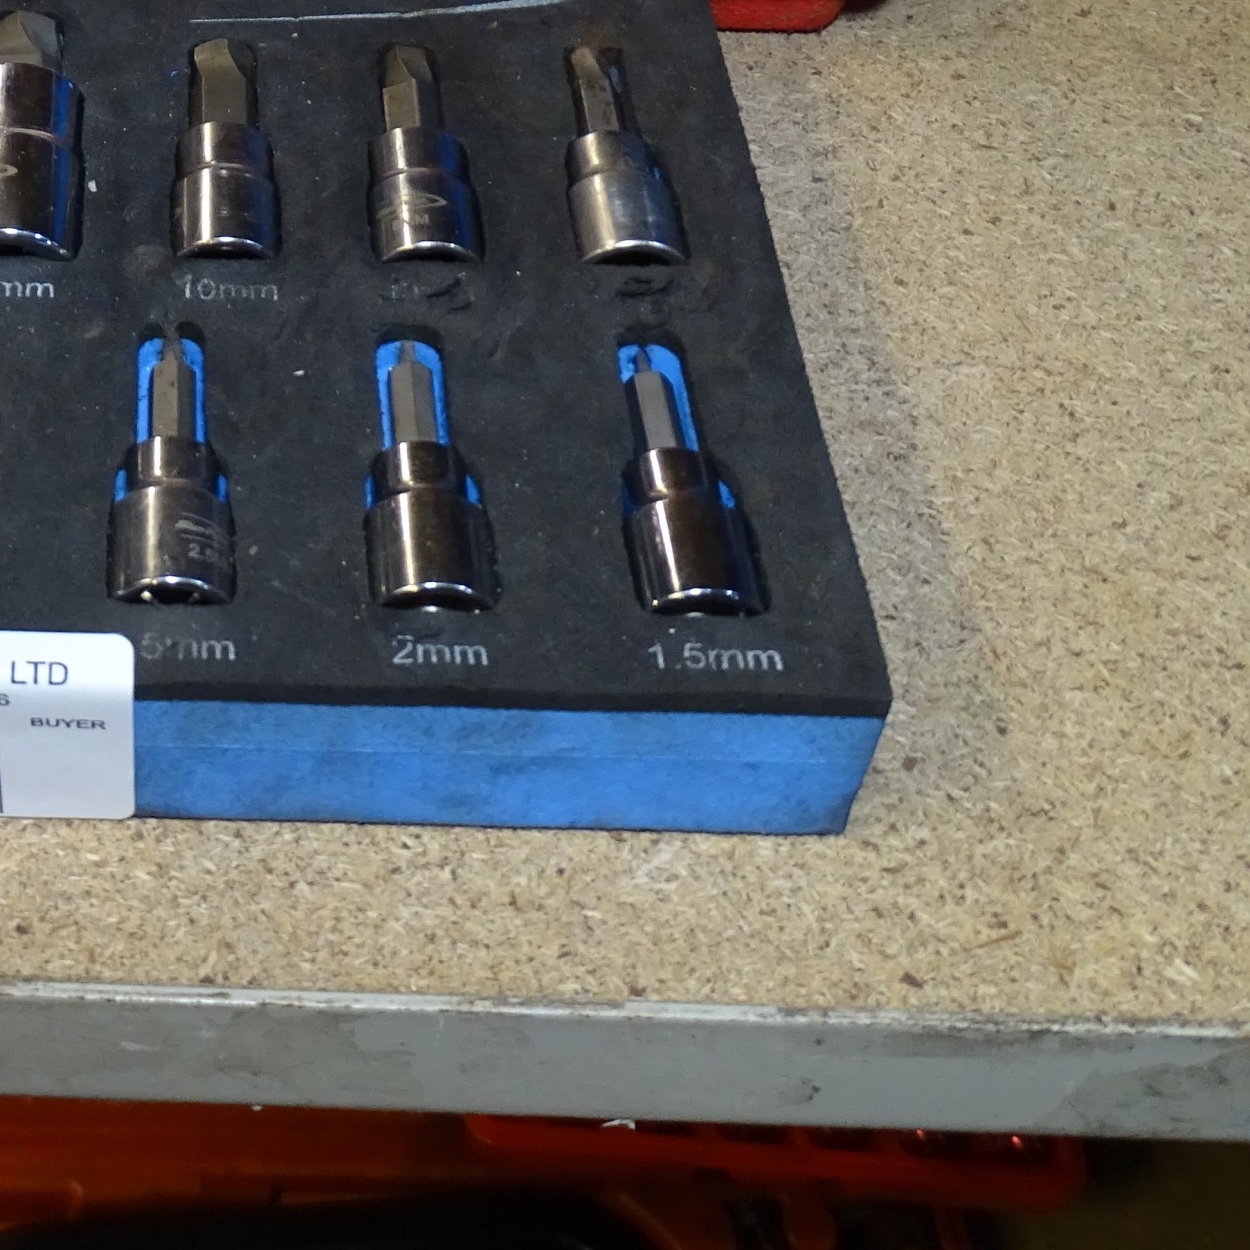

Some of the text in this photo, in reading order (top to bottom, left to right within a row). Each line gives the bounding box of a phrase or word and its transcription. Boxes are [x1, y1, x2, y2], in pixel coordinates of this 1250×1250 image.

[182, 274, 279, 302] 10mm
[391, 635, 489, 667] 2mm
[10, 660, 69, 686] LTD
[30, 717, 107, 731] BUYER
